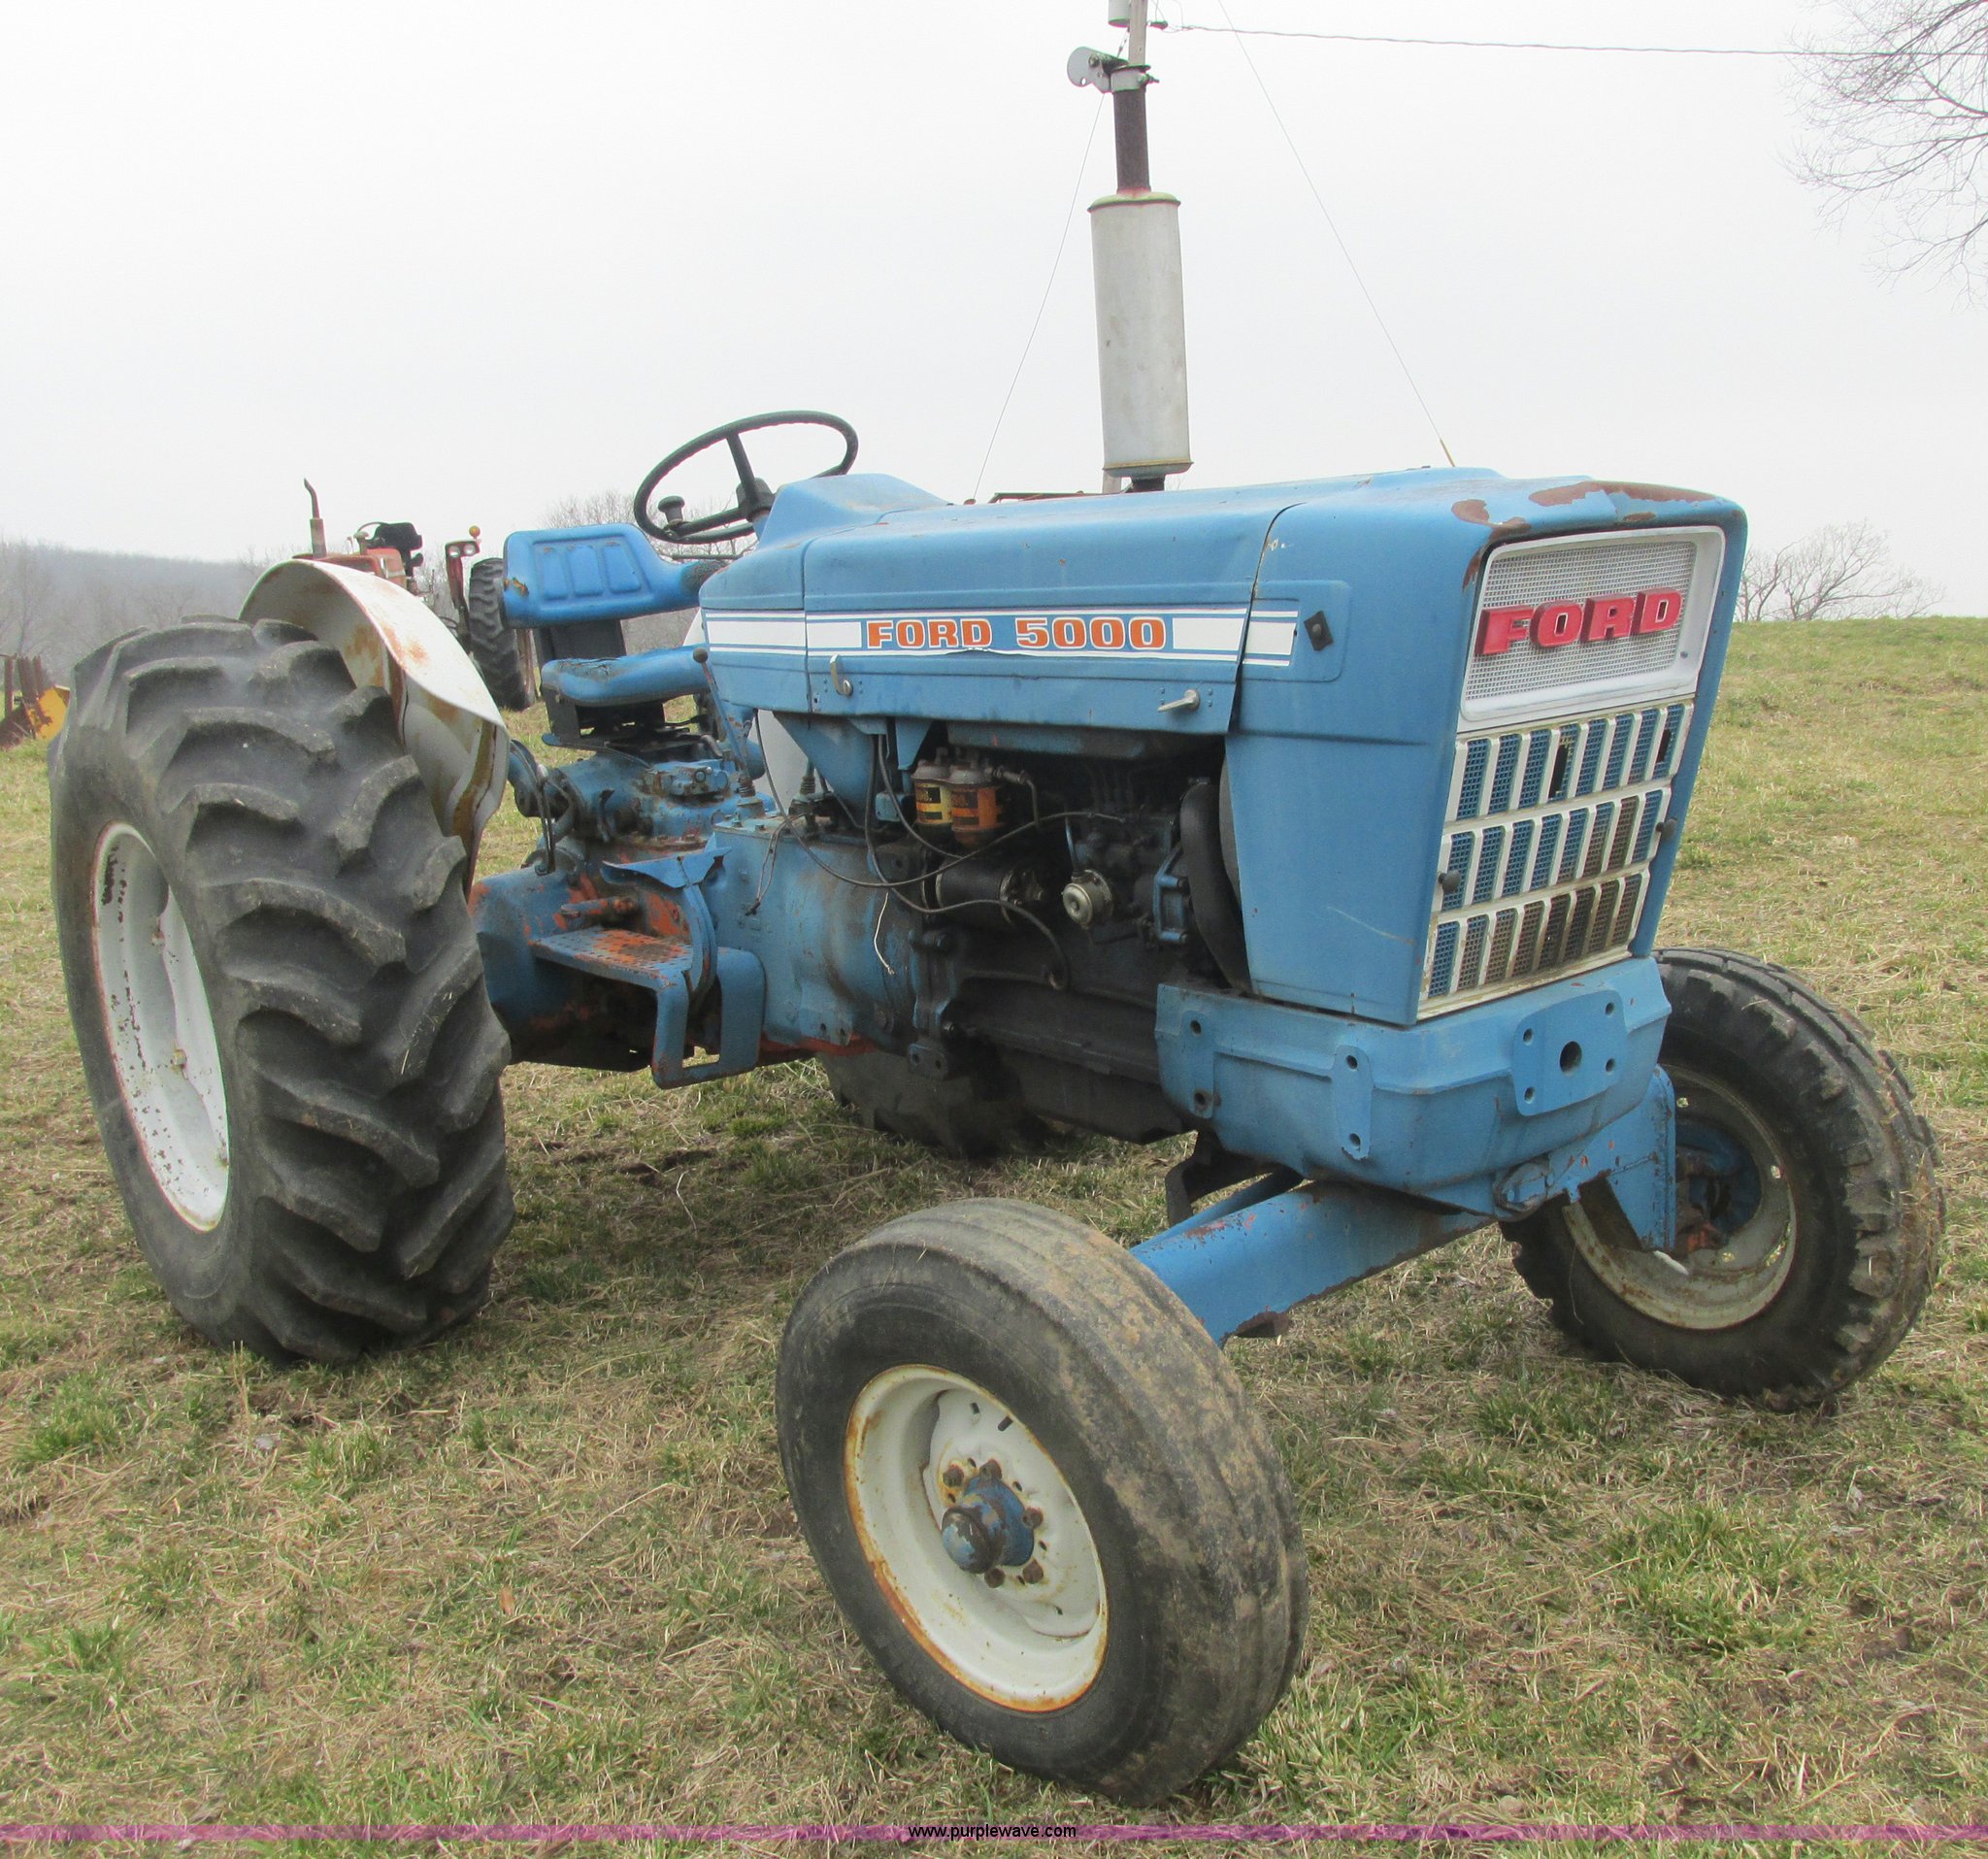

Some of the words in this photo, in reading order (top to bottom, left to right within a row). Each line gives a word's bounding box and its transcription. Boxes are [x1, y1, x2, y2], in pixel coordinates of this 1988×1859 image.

[867, 619, 991, 648] FORD
[1015, 616, 1166, 649] 5000
[1474, 587, 1682, 654] FORD
